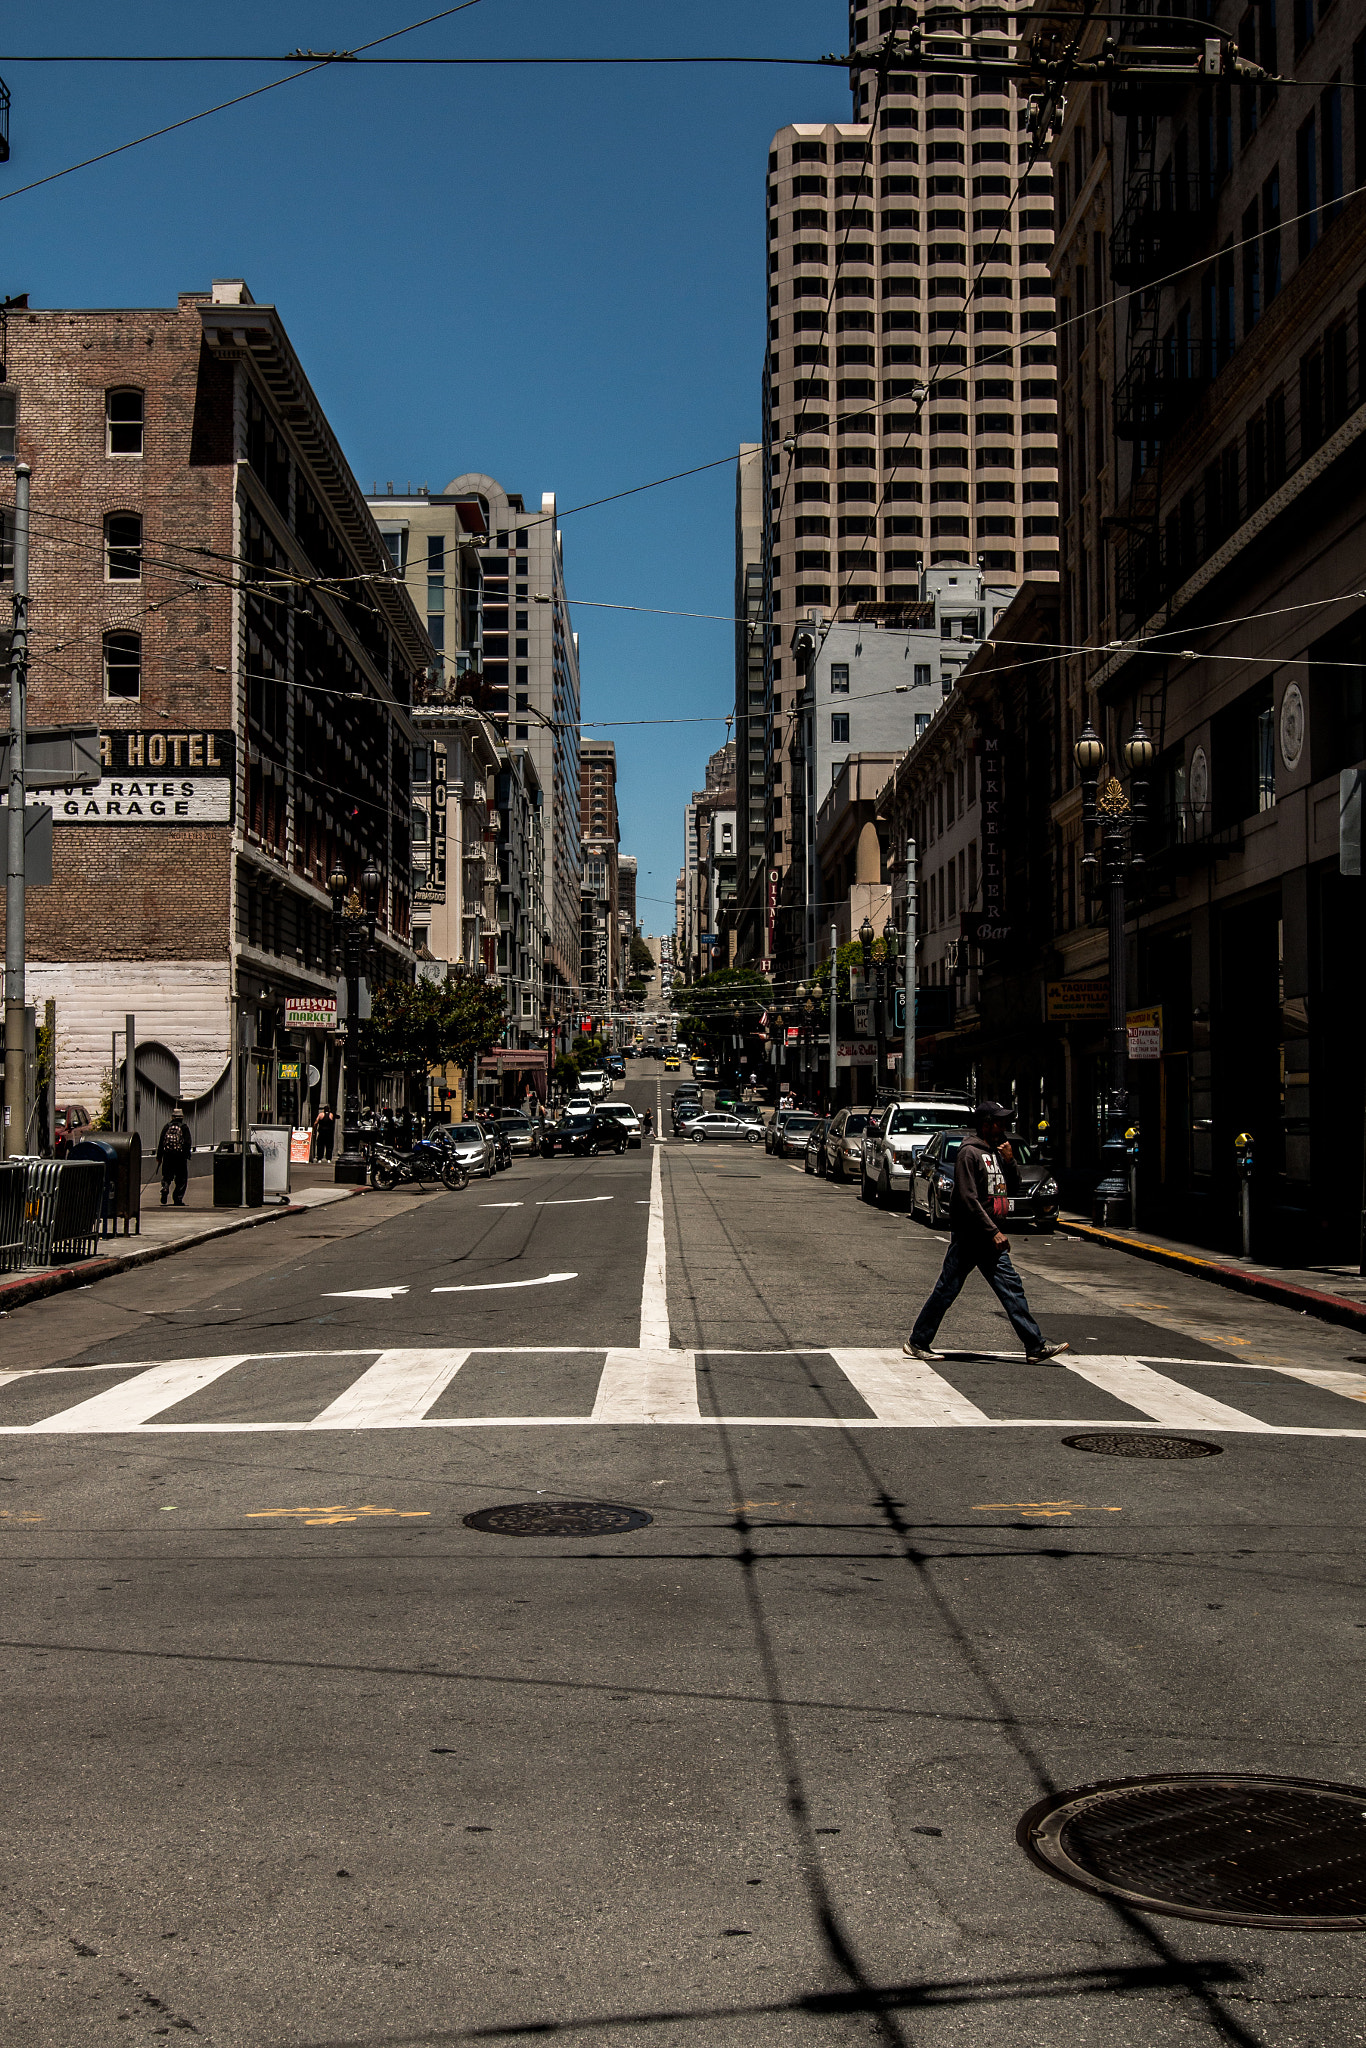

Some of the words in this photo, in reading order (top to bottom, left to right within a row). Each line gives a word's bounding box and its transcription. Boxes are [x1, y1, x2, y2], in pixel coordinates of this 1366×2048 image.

[127, 734, 221, 767] HOTEL
[111, 783, 194, 796] RATES
[64, 801, 189, 815] GARAGE
[434, 757, 447, 886] HOTEL
[985, 739, 1001, 918] MIKKELLER
[976, 924, 1011, 940] Bar
[1061, 983, 1110, 992] TAQUERIA
[1062, 993, 1108, 1002] CASTILLO
[286, 998, 337, 1011] MASON
[289, 1012, 333, 1022] MARKET
[1128, 1028, 1138, 1037] NO
[837, 1044, 858, 1056] Little
[858, 1044, 877, 1056] Delhi
